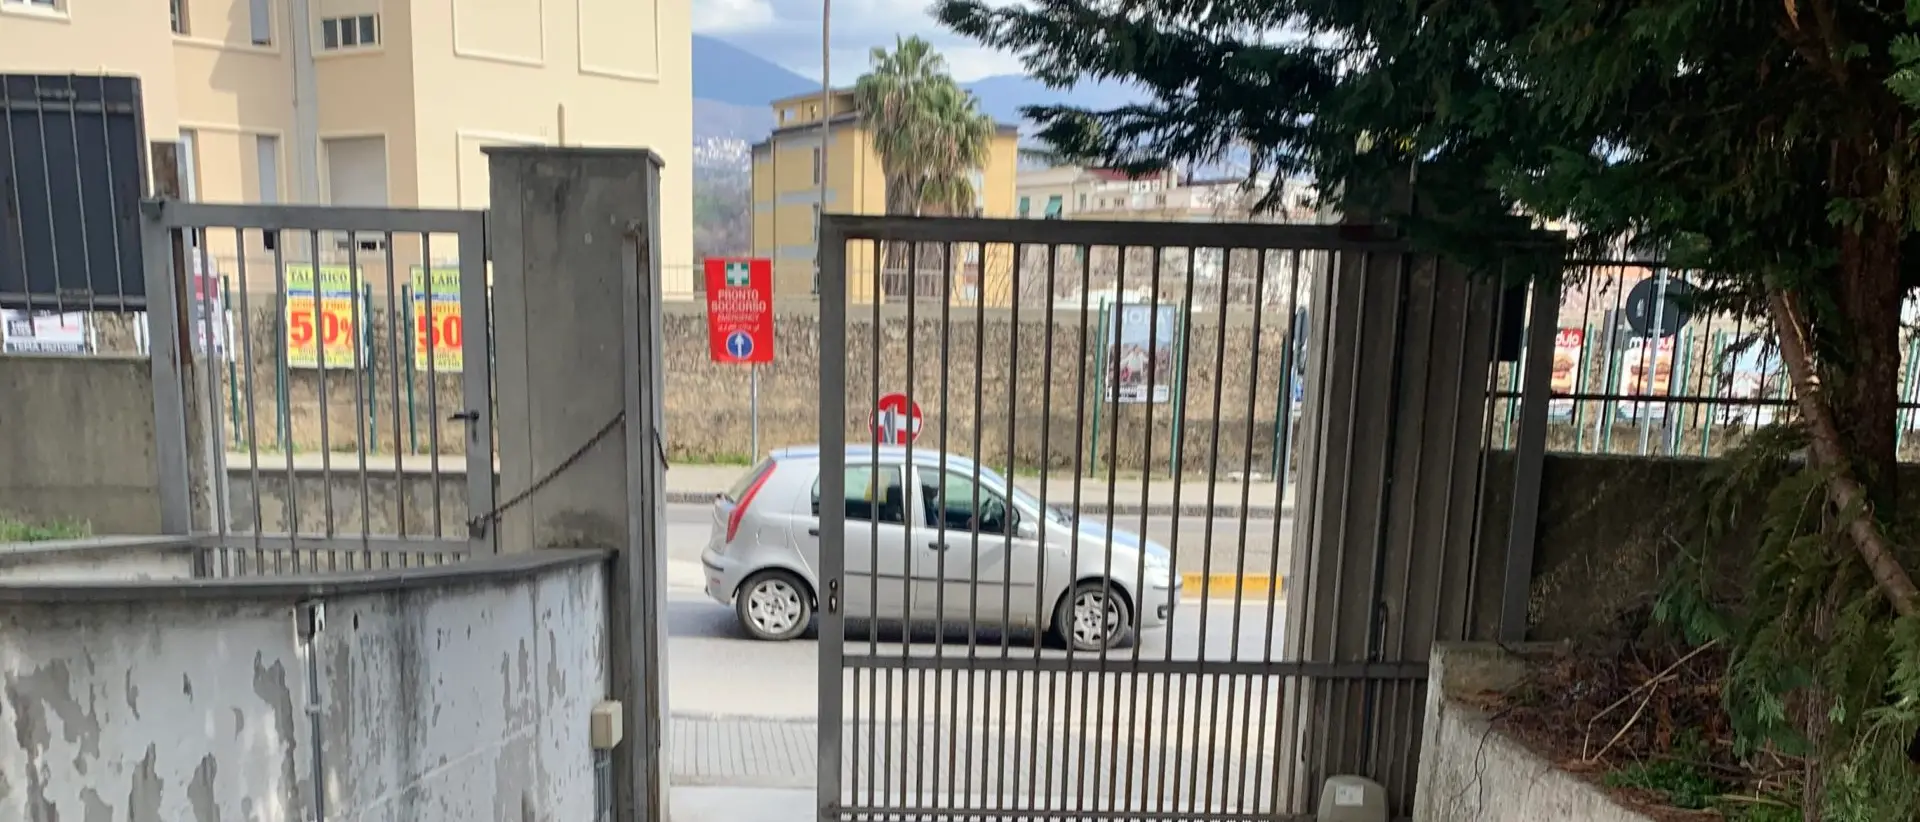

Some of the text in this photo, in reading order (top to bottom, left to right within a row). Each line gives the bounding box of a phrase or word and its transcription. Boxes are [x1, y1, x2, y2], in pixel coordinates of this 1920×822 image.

[290, 270, 348, 282] TALRICO
[718, 289, 759, 300] PRONTO
[711, 301, 766, 313] SOCCORSO
